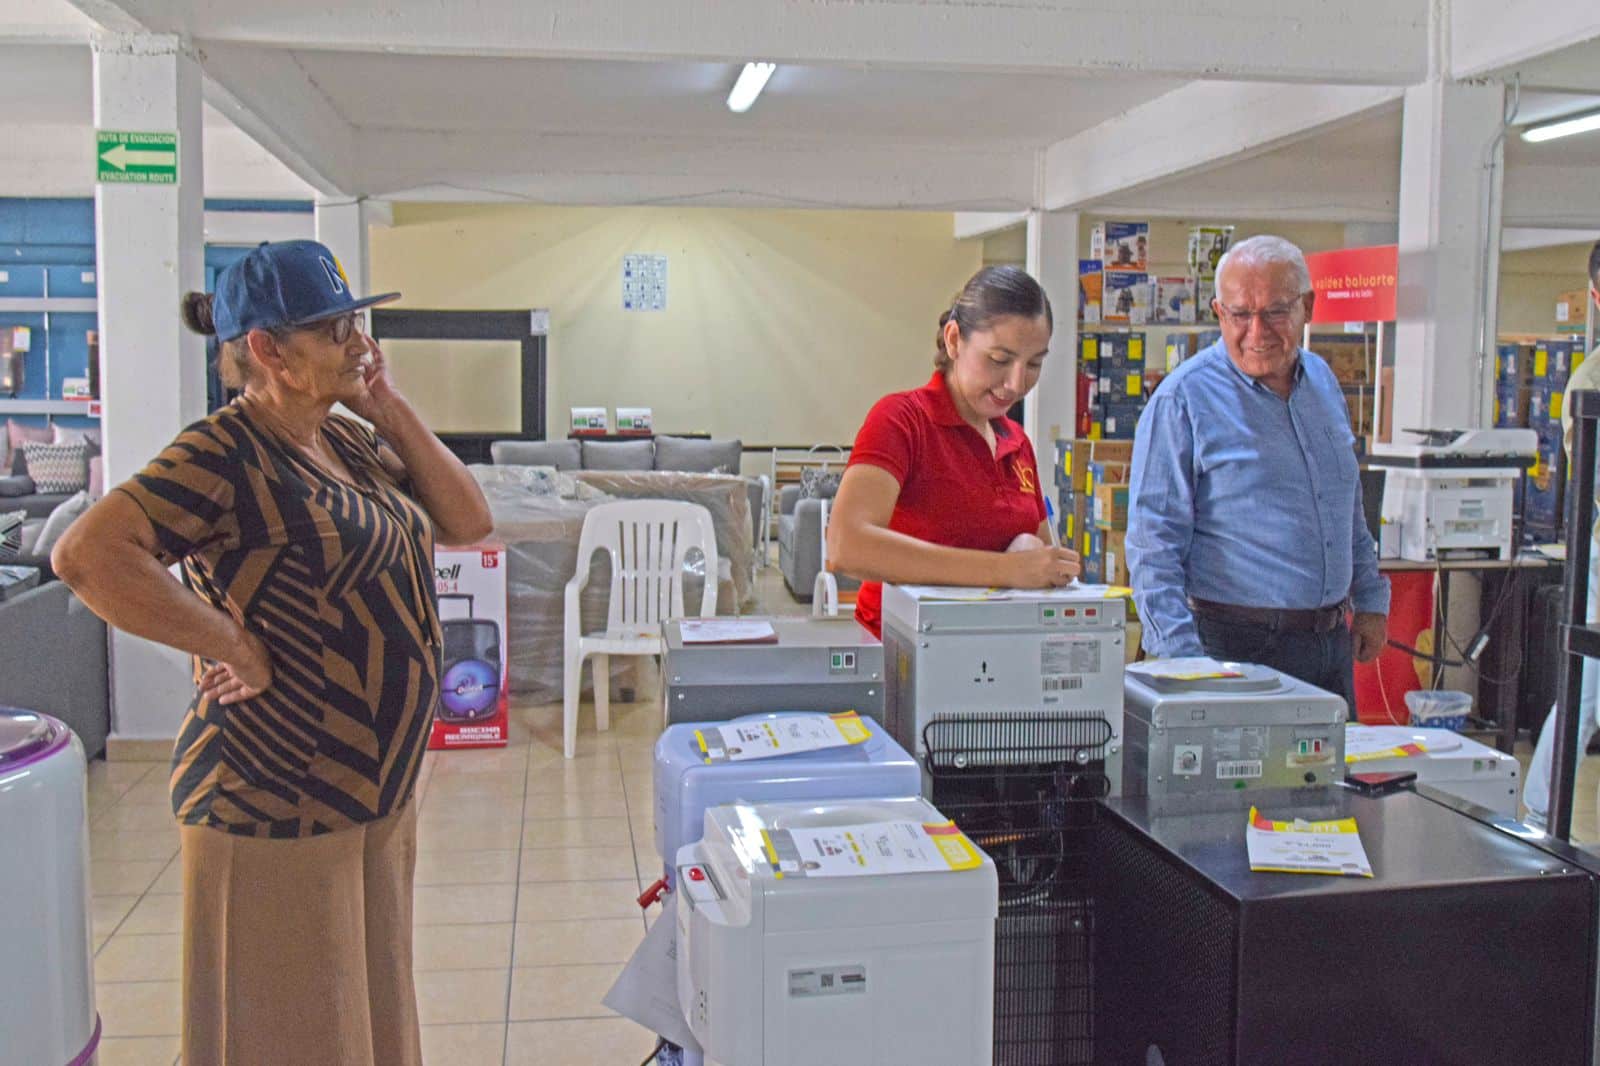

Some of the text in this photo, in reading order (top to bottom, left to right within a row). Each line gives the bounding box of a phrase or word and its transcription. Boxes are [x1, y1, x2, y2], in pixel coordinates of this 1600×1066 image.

[98, 132, 119, 143] RUTA
[120, 133, 129, 144] DE
[100, 171, 174, 182] EVACUATION ROUTE
[1345, 273, 1394, 288] baluarte
[1286, 823, 1340, 833] ORTA
